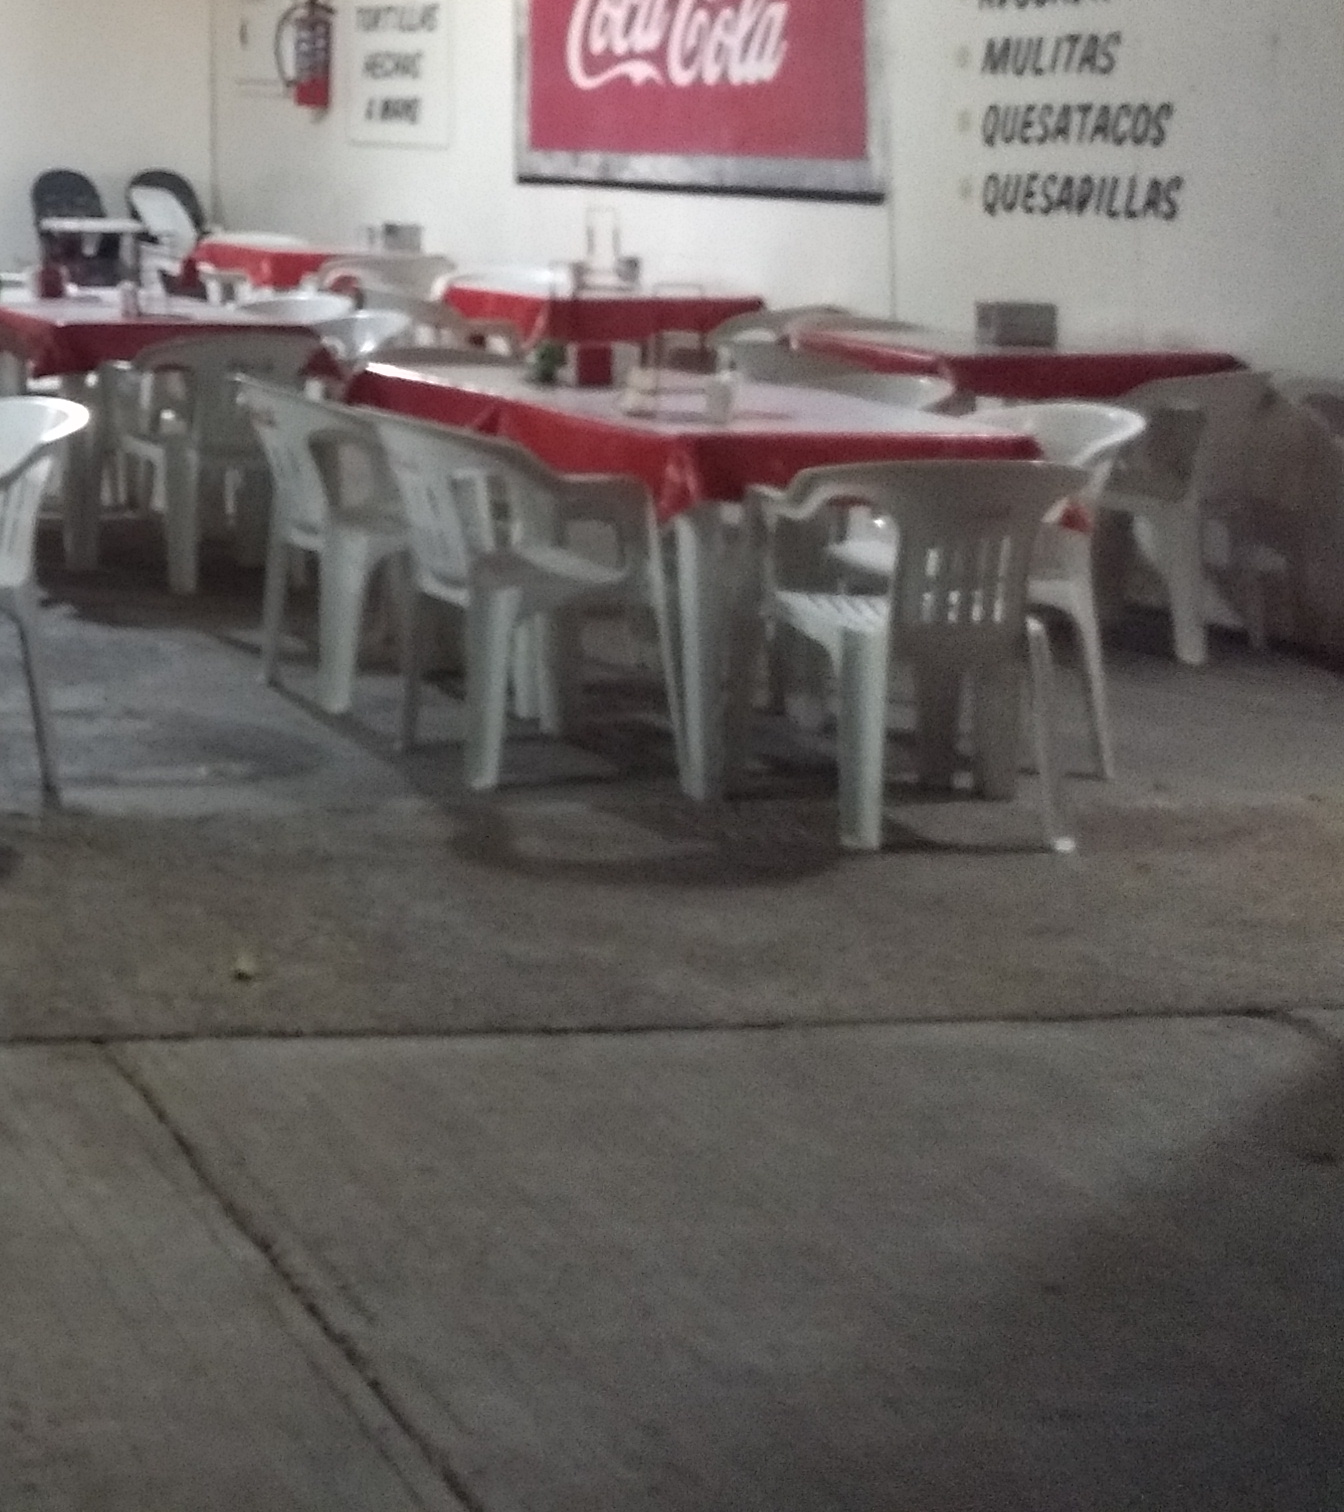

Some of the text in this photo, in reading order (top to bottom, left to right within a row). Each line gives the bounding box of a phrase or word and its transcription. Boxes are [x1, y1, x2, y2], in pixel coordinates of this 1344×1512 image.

[981, 31, 1121, 76] MULITAS
[981, 101, 1174, 148] QUESATACOS
[982, 173, 1183, 221] QUESADILLAS
